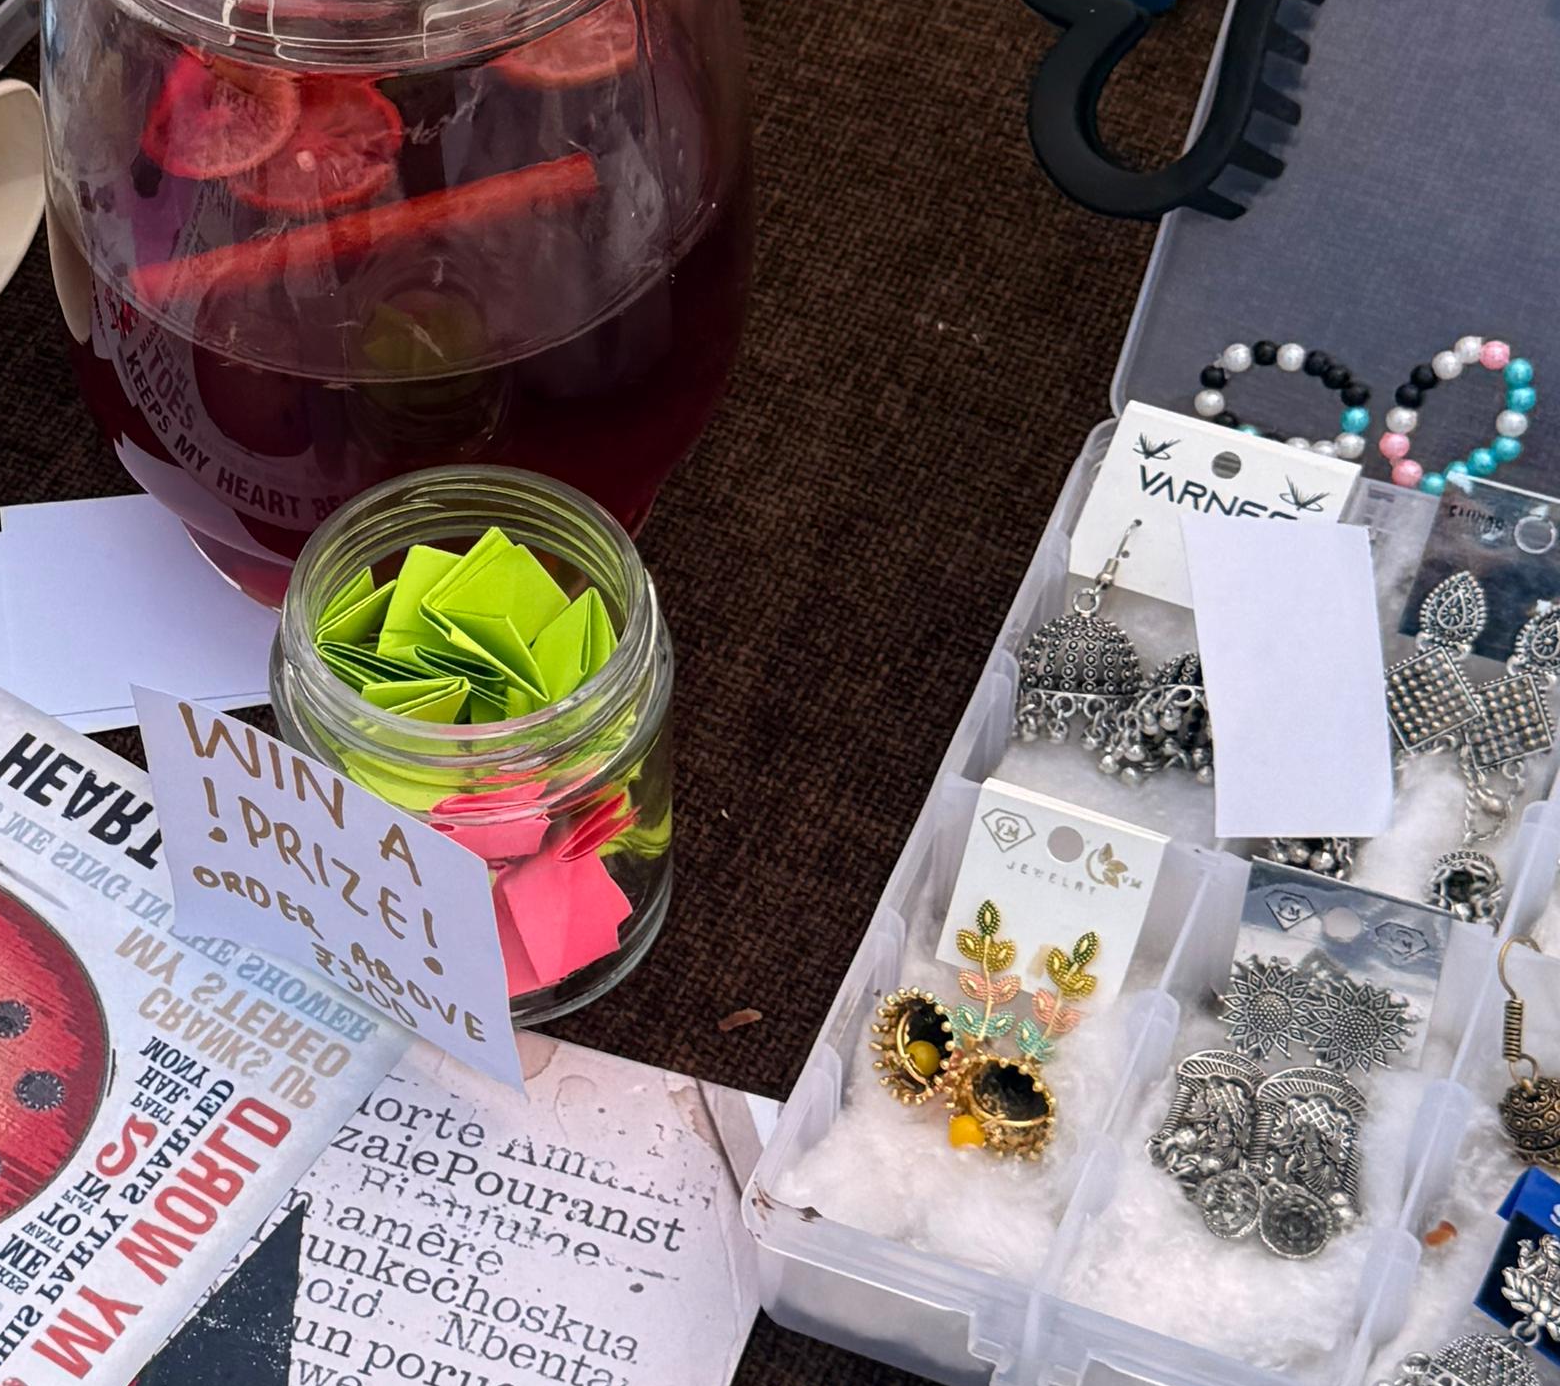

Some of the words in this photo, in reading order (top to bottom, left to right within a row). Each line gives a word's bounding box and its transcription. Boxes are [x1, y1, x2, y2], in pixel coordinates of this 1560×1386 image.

[124, 349, 172, 434] KEEPS
[172, 432, 210, 471] MY
[214, 466, 301, 519] HEART
[177, 701, 345, 830] WIN
[378, 822, 421, 886] A
[192, 864, 324, 941] ORDER
[350, 941, 486, 1043] ABOVE
